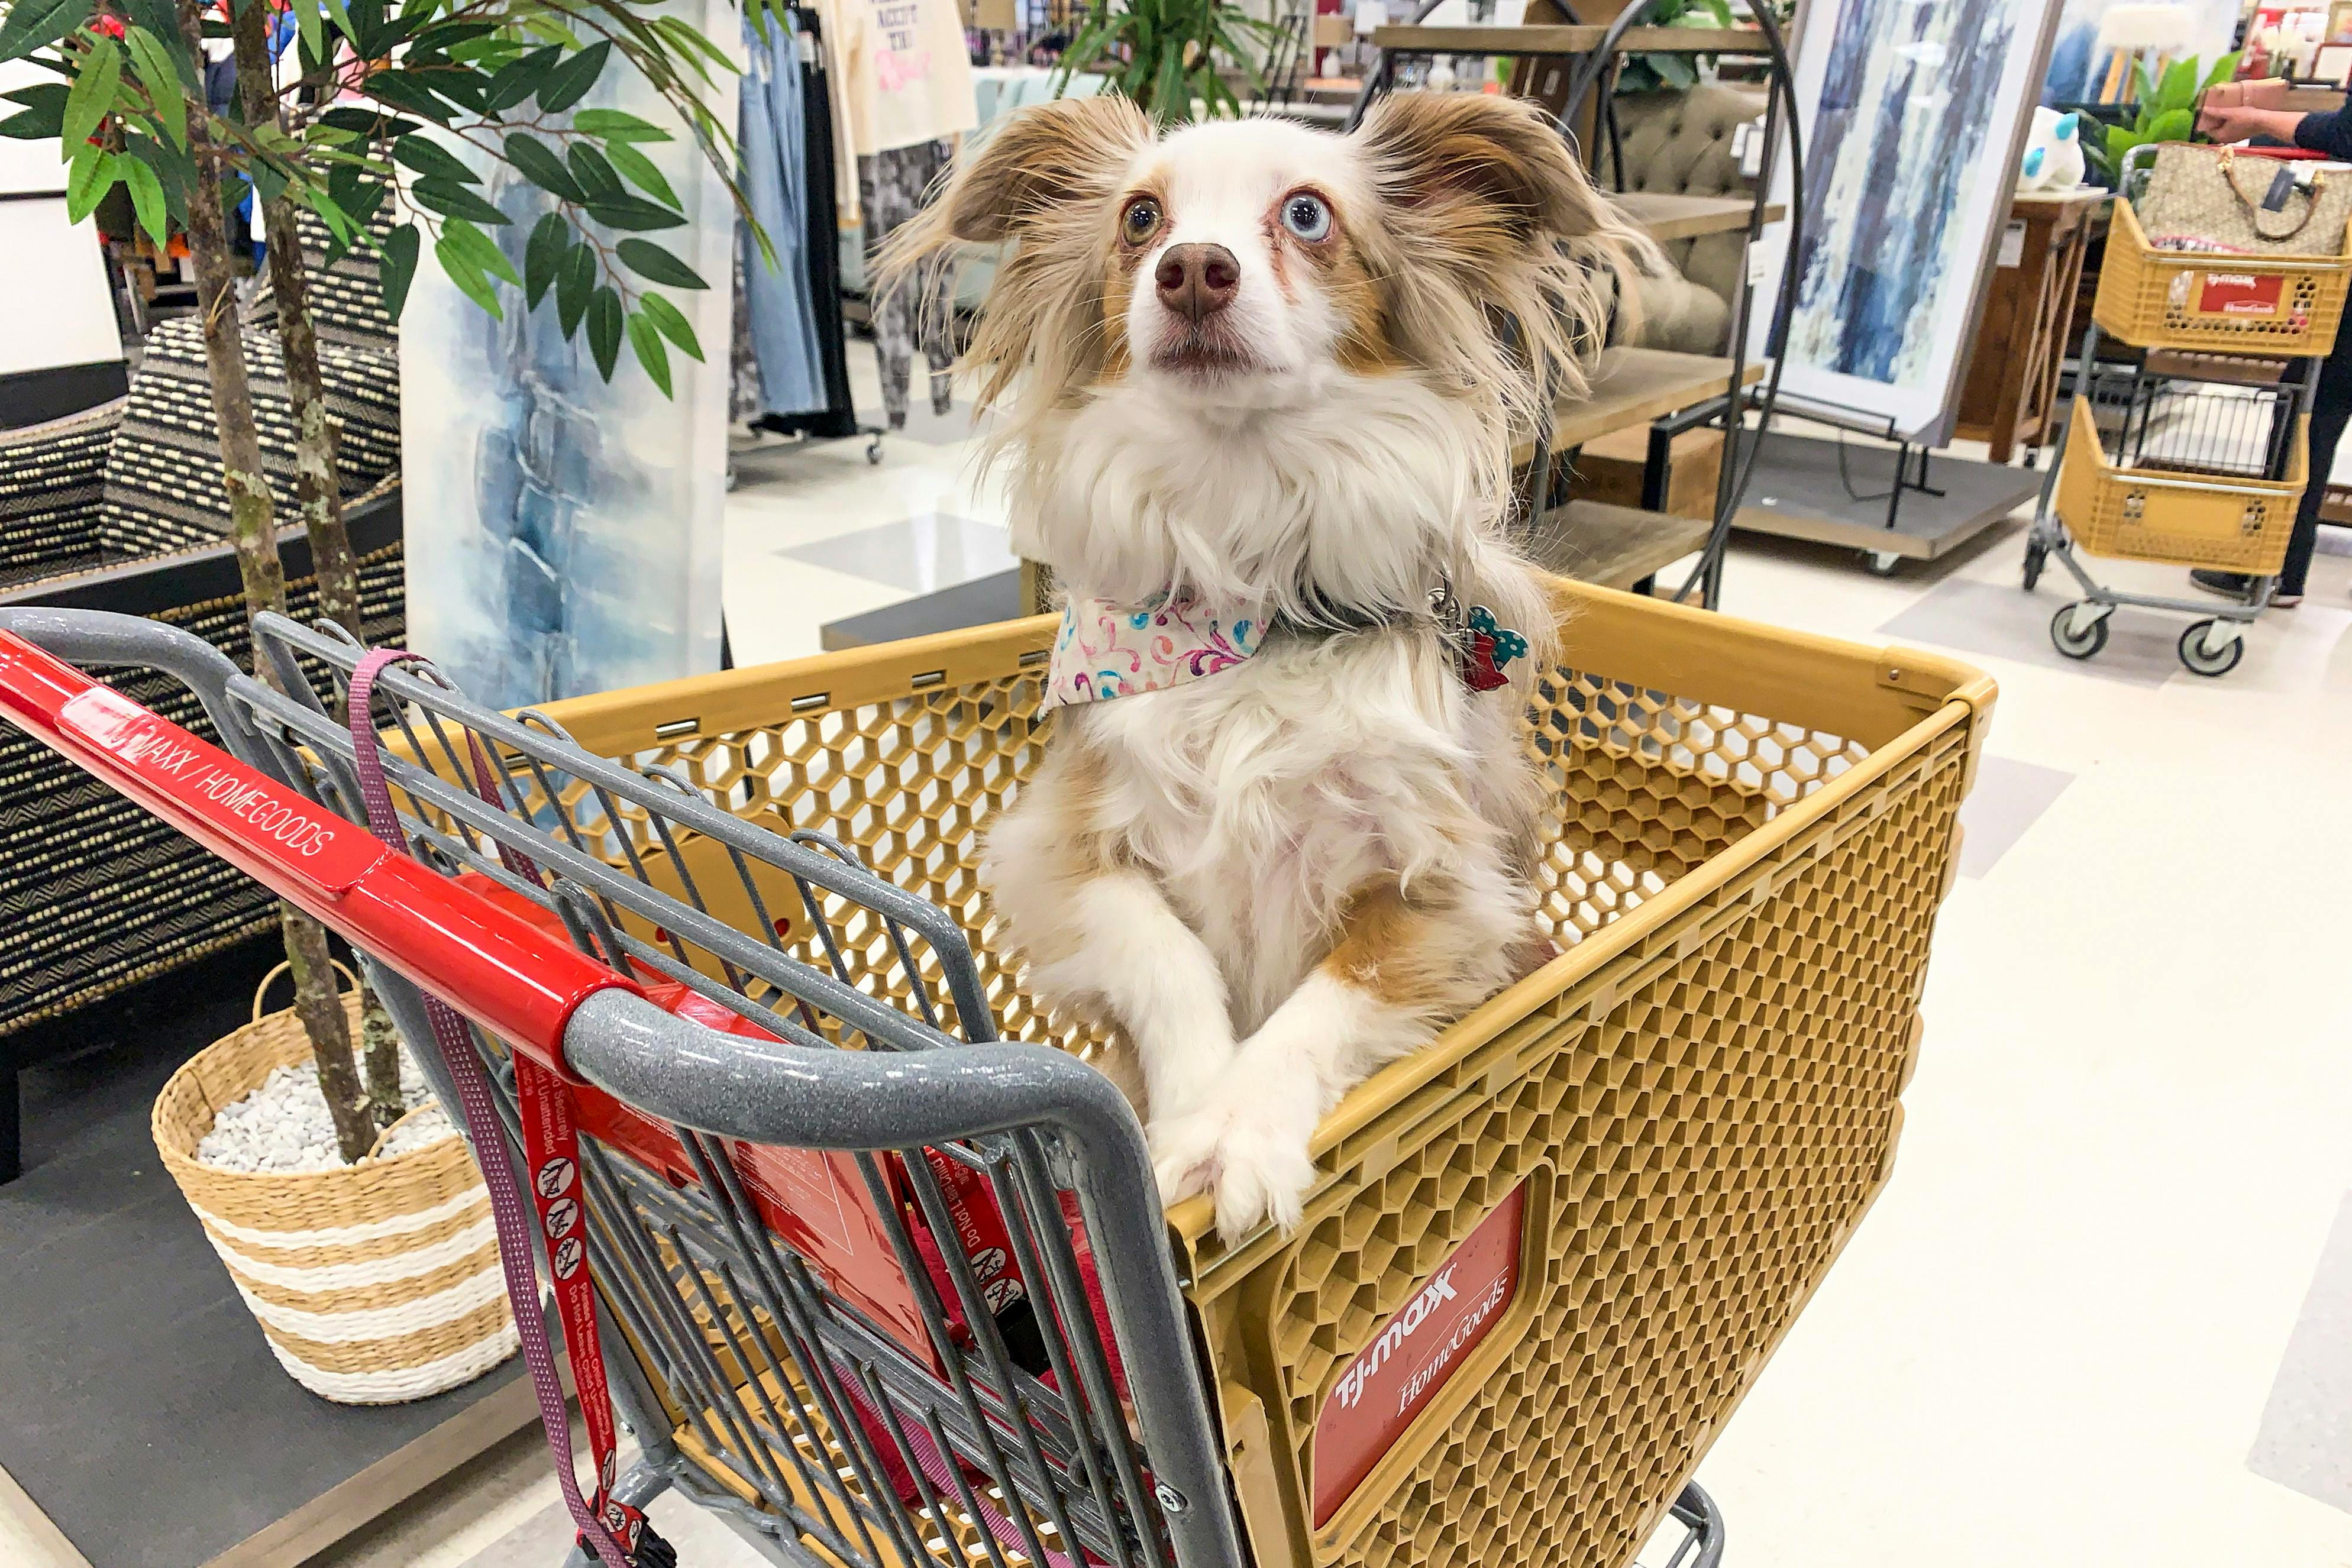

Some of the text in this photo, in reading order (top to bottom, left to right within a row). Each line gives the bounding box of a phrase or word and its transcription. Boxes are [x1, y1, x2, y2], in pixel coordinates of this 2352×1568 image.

[195, 769, 335, 857] HOMEGOODS
[538, 1085, 557, 1155] Unattended
[554, 1090, 569, 1141] Securely
[931, 1157, 952, 1187] Child
[954, 1207, 973, 1231] Not
[967, 1229, 981, 1248] Do
[569, 1284, 577, 1304] Do
[1397, 1277, 1508, 1418] HomeGoods
